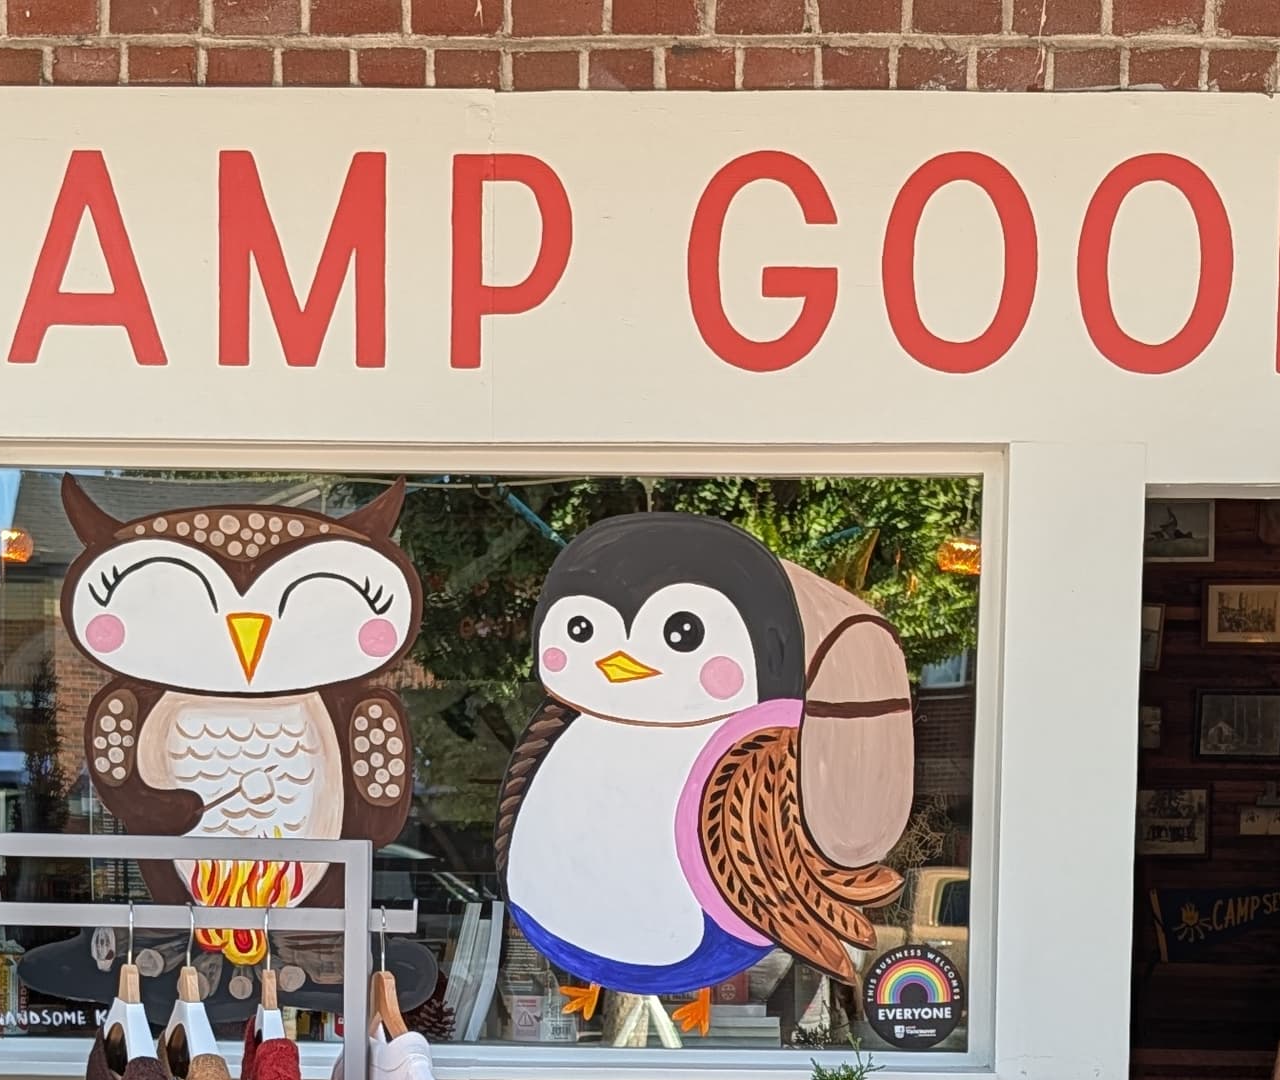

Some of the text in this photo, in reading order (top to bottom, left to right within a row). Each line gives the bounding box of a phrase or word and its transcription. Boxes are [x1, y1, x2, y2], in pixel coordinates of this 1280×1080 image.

[1211, 895, 1261, 931] CAMP
[866, 949, 961, 1002] THIS BUSINESS WELCOMES
[95, 1009, 109, 1026] K
[877, 1007, 952, 1021] EVERYONE
